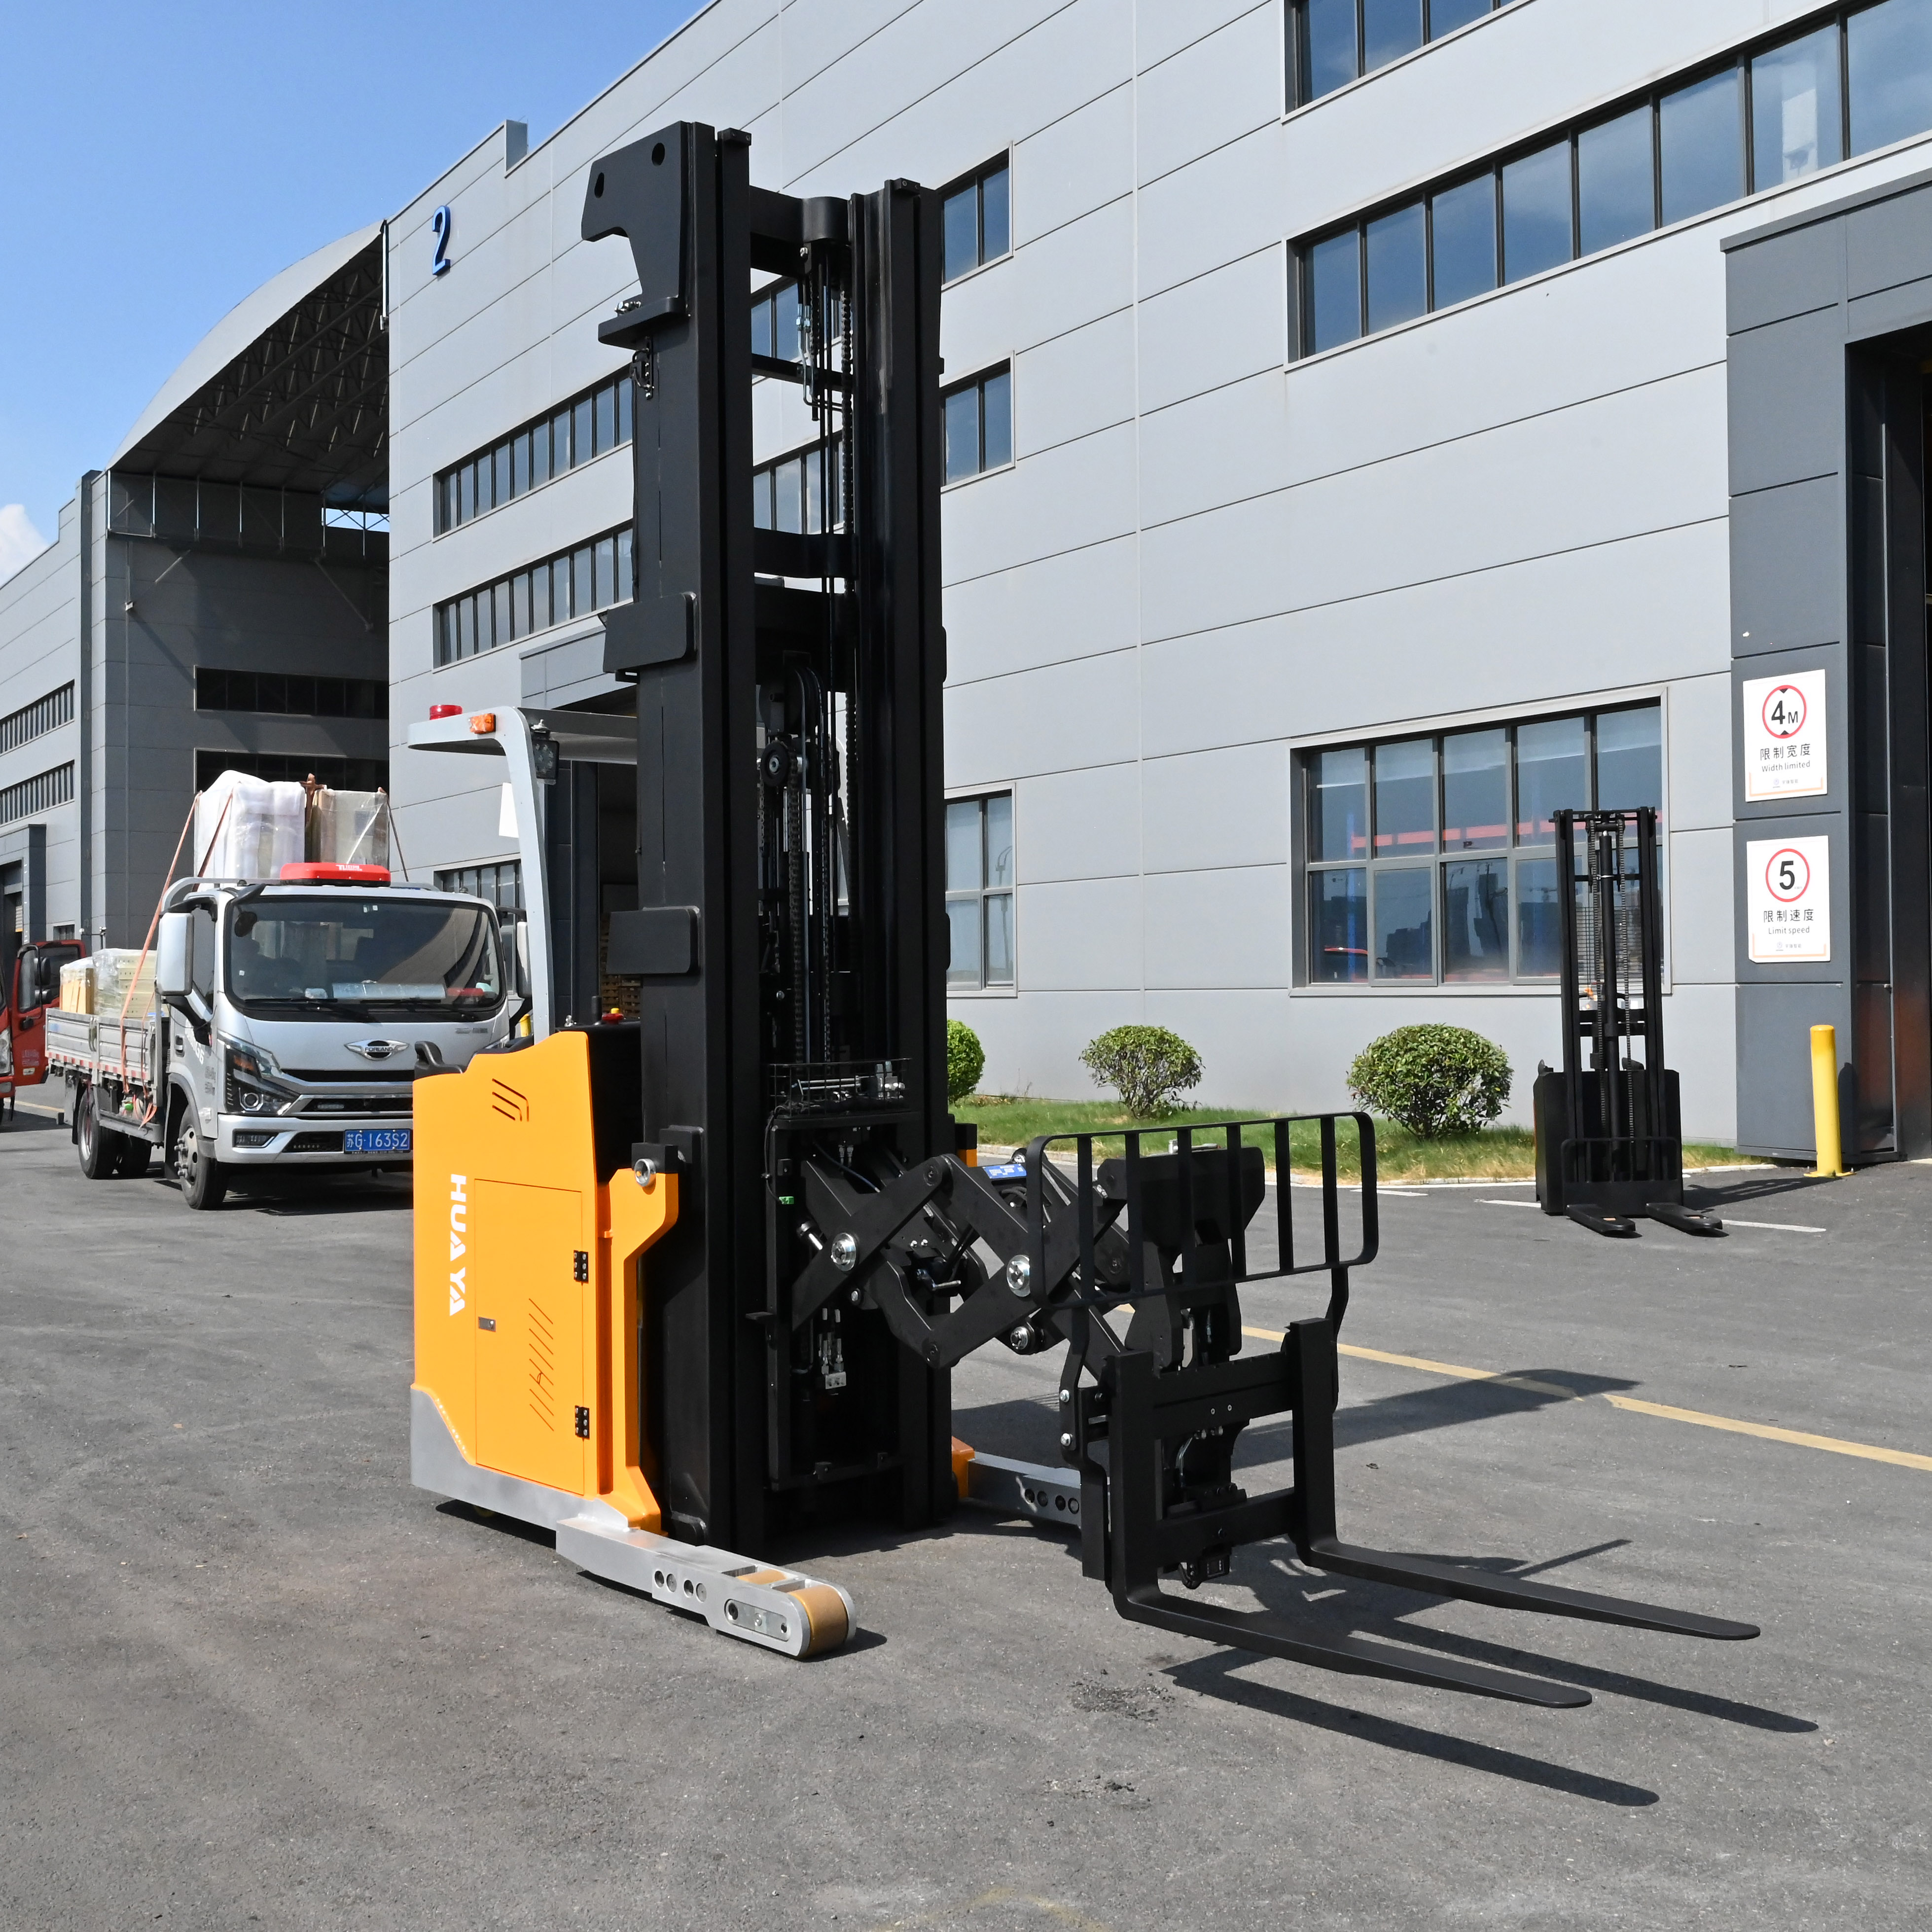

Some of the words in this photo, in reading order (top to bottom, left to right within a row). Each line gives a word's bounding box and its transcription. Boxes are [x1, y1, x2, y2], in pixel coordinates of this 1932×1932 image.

[432, 205, 451, 276] 2
[1760, 744, 1810, 761] 限制宽度
[1761, 763, 1783, 772] Width
[1785, 760, 1810, 770] limited
[1779, 860, 1795, 890] 5
[1763, 909, 1814, 923] 限制速度
[1789, 926, 1810, 935] speed
